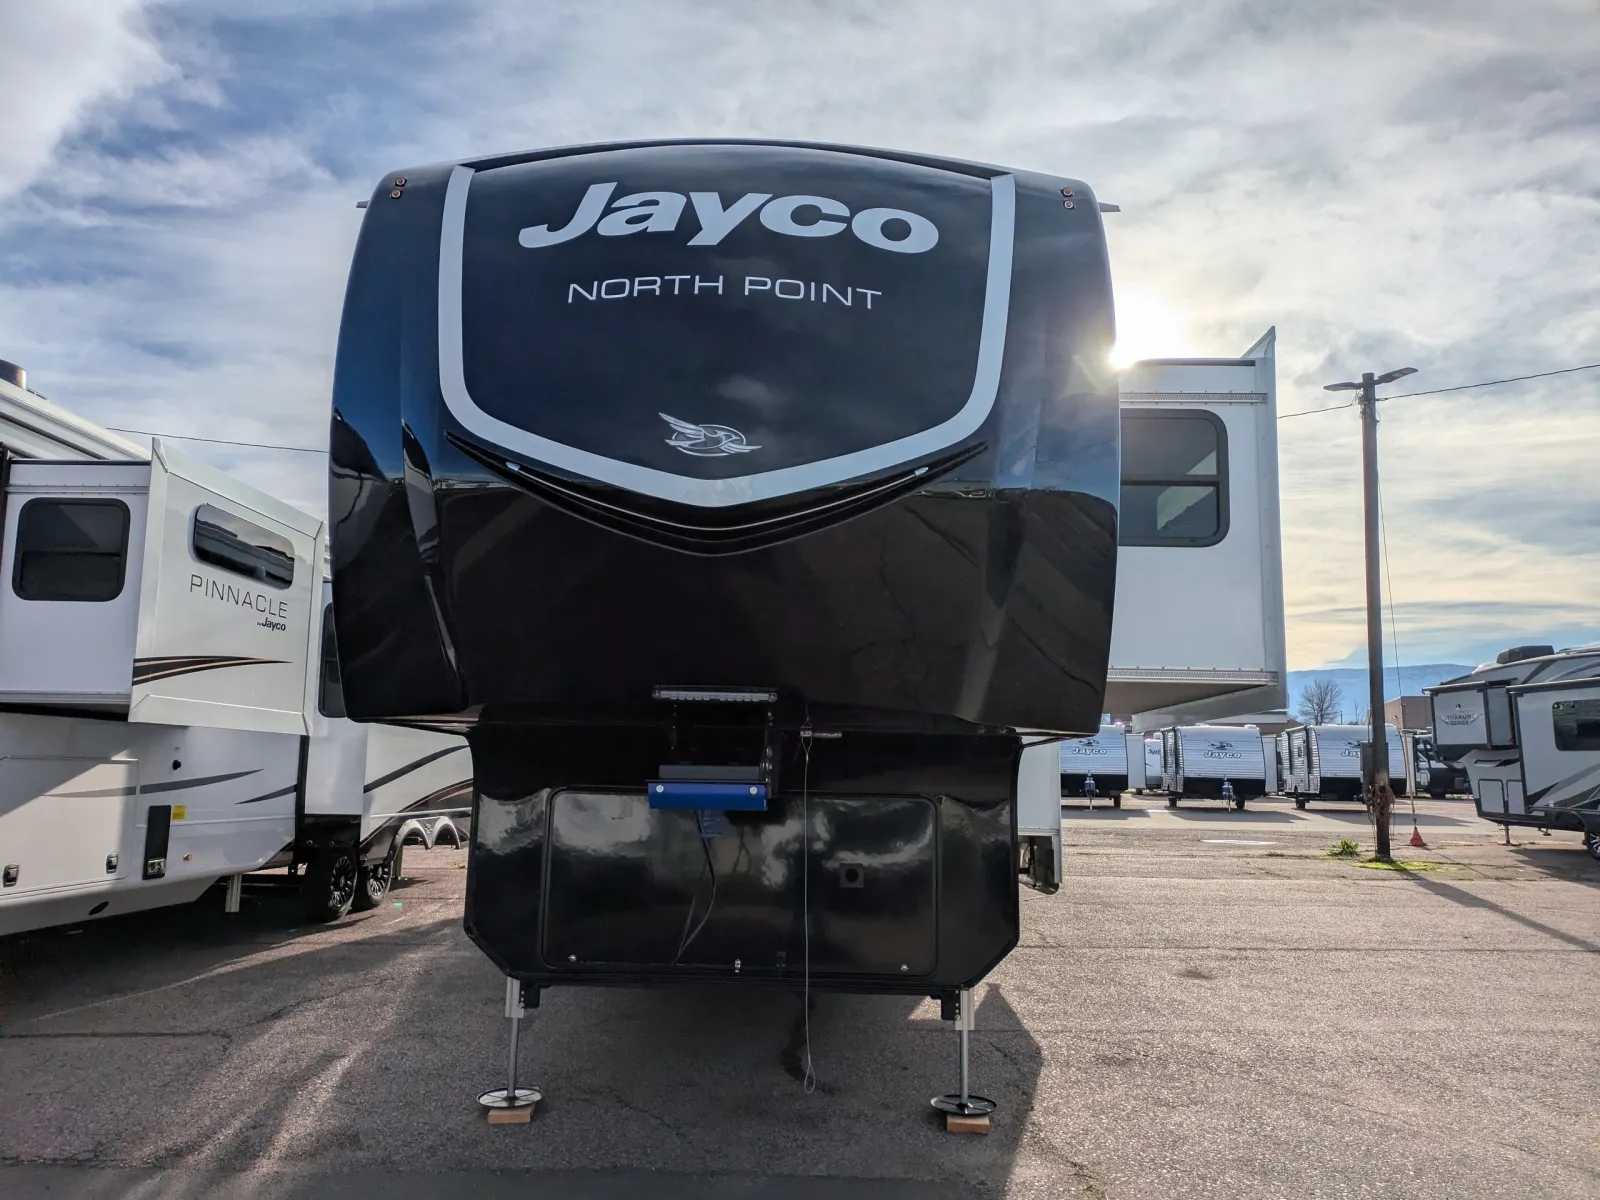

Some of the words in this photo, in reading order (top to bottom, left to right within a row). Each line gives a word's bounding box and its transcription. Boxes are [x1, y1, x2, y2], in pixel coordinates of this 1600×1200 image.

[518, 181, 939, 254] Jayco
[567, 275, 723, 303] NORTH
[744, 276, 882, 309] POINT
[190, 573, 288, 619] PINNACLE
[261, 617, 287, 631] Jayco
[1071, 747, 1108, 755] Jayco
[1204, 750, 1241, 759] Jayco
[1341, 749, 1361, 758] Jay
